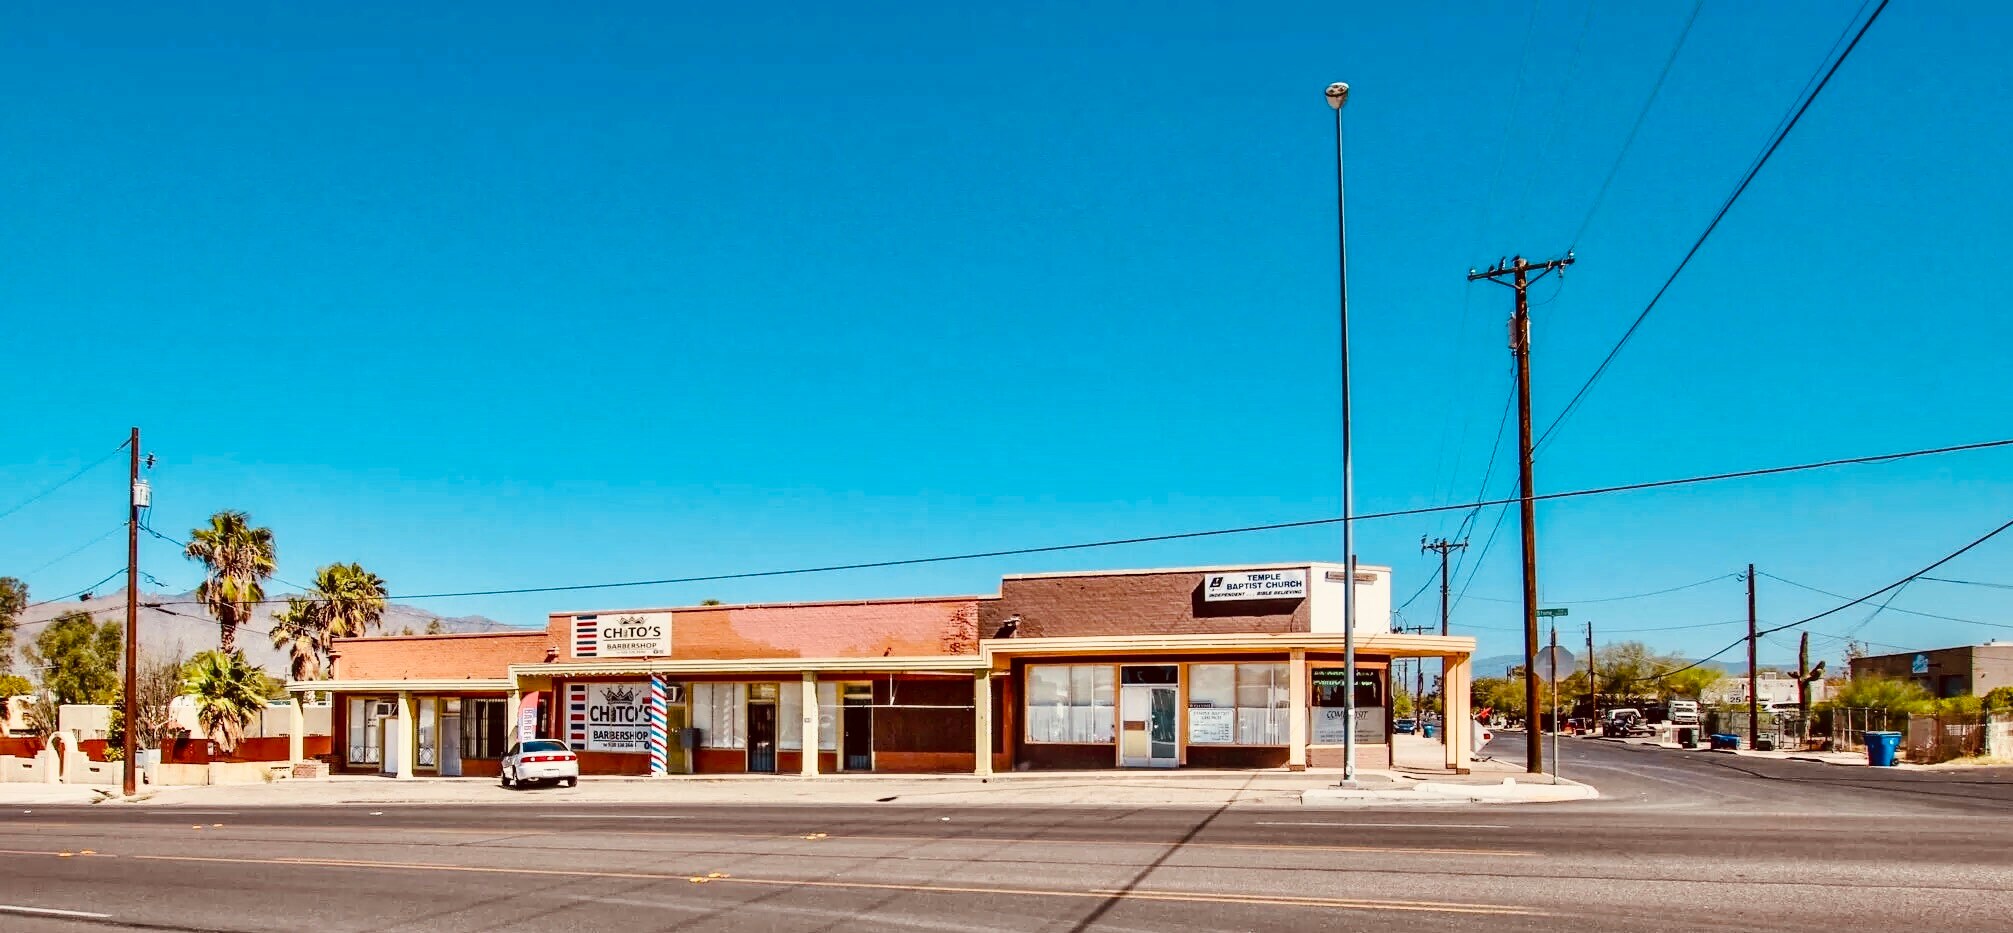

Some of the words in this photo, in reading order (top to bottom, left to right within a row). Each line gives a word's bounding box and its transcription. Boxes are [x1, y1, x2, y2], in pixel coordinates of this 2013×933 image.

[1247, 573, 1281, 581] TEMPLE
[1226, 582, 1262, 590] BAPTIST
[1265, 580, 1303, 588] CHURCH
[603, 626, 661, 638] CHITO'S
[593, 730, 648, 740] BARBERSHOP
